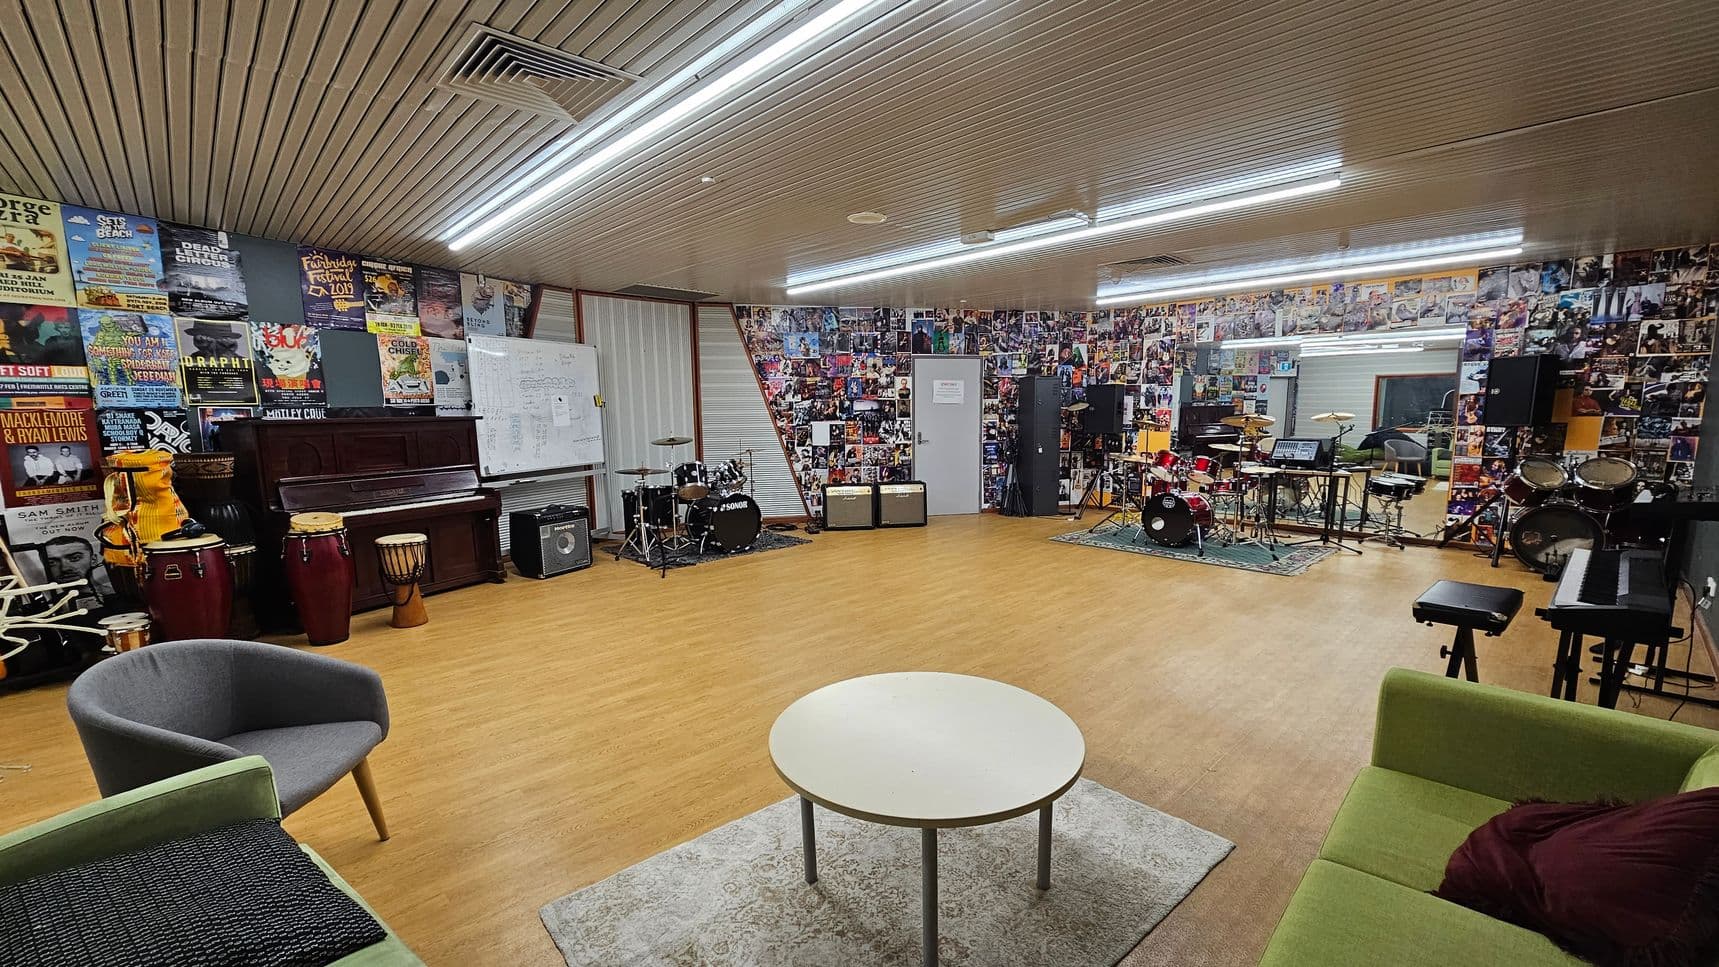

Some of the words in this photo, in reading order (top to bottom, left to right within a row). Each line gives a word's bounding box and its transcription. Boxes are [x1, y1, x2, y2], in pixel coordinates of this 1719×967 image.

[96, 214, 127, 226] SETS
[96, 228, 133, 239] BEACH
[181, 241, 220, 253] DEAD
[175, 247, 229, 261] LETTER
[175, 255, 231, 268] CIRCUS
[301, 254, 357, 272] Fairbridge
[307, 269, 353, 284] Festival
[20, 280, 44, 288] HILL
[329, 283, 354, 294] 2019
[121, 336, 141, 347] YOU
[145, 337, 159, 347] AM
[391, 340, 417, 348] COLD
[87, 345, 134, 358] SOMETHING
[138, 348, 153, 358] FOR
[388, 347, 423, 355] CHISEL
[121, 359, 170, 370] SPIDERBAIT
[185, 356, 250, 368] DRAPHT
[18, 365, 50, 377] SOFT
[131, 370, 176, 382] JEBEDIAH
[100, 390, 128, 399] GREEN
[0, 411, 86, 428] MACKLEMORE
[4, 428, 16, 444] &
[17, 428, 51, 443] RYAN
[52, 426, 88, 442] LEWIS
[17, 509, 49, 519] SAM
[56, 504, 99, 515] SMITH
[726, 500, 748, 511] SONOR
